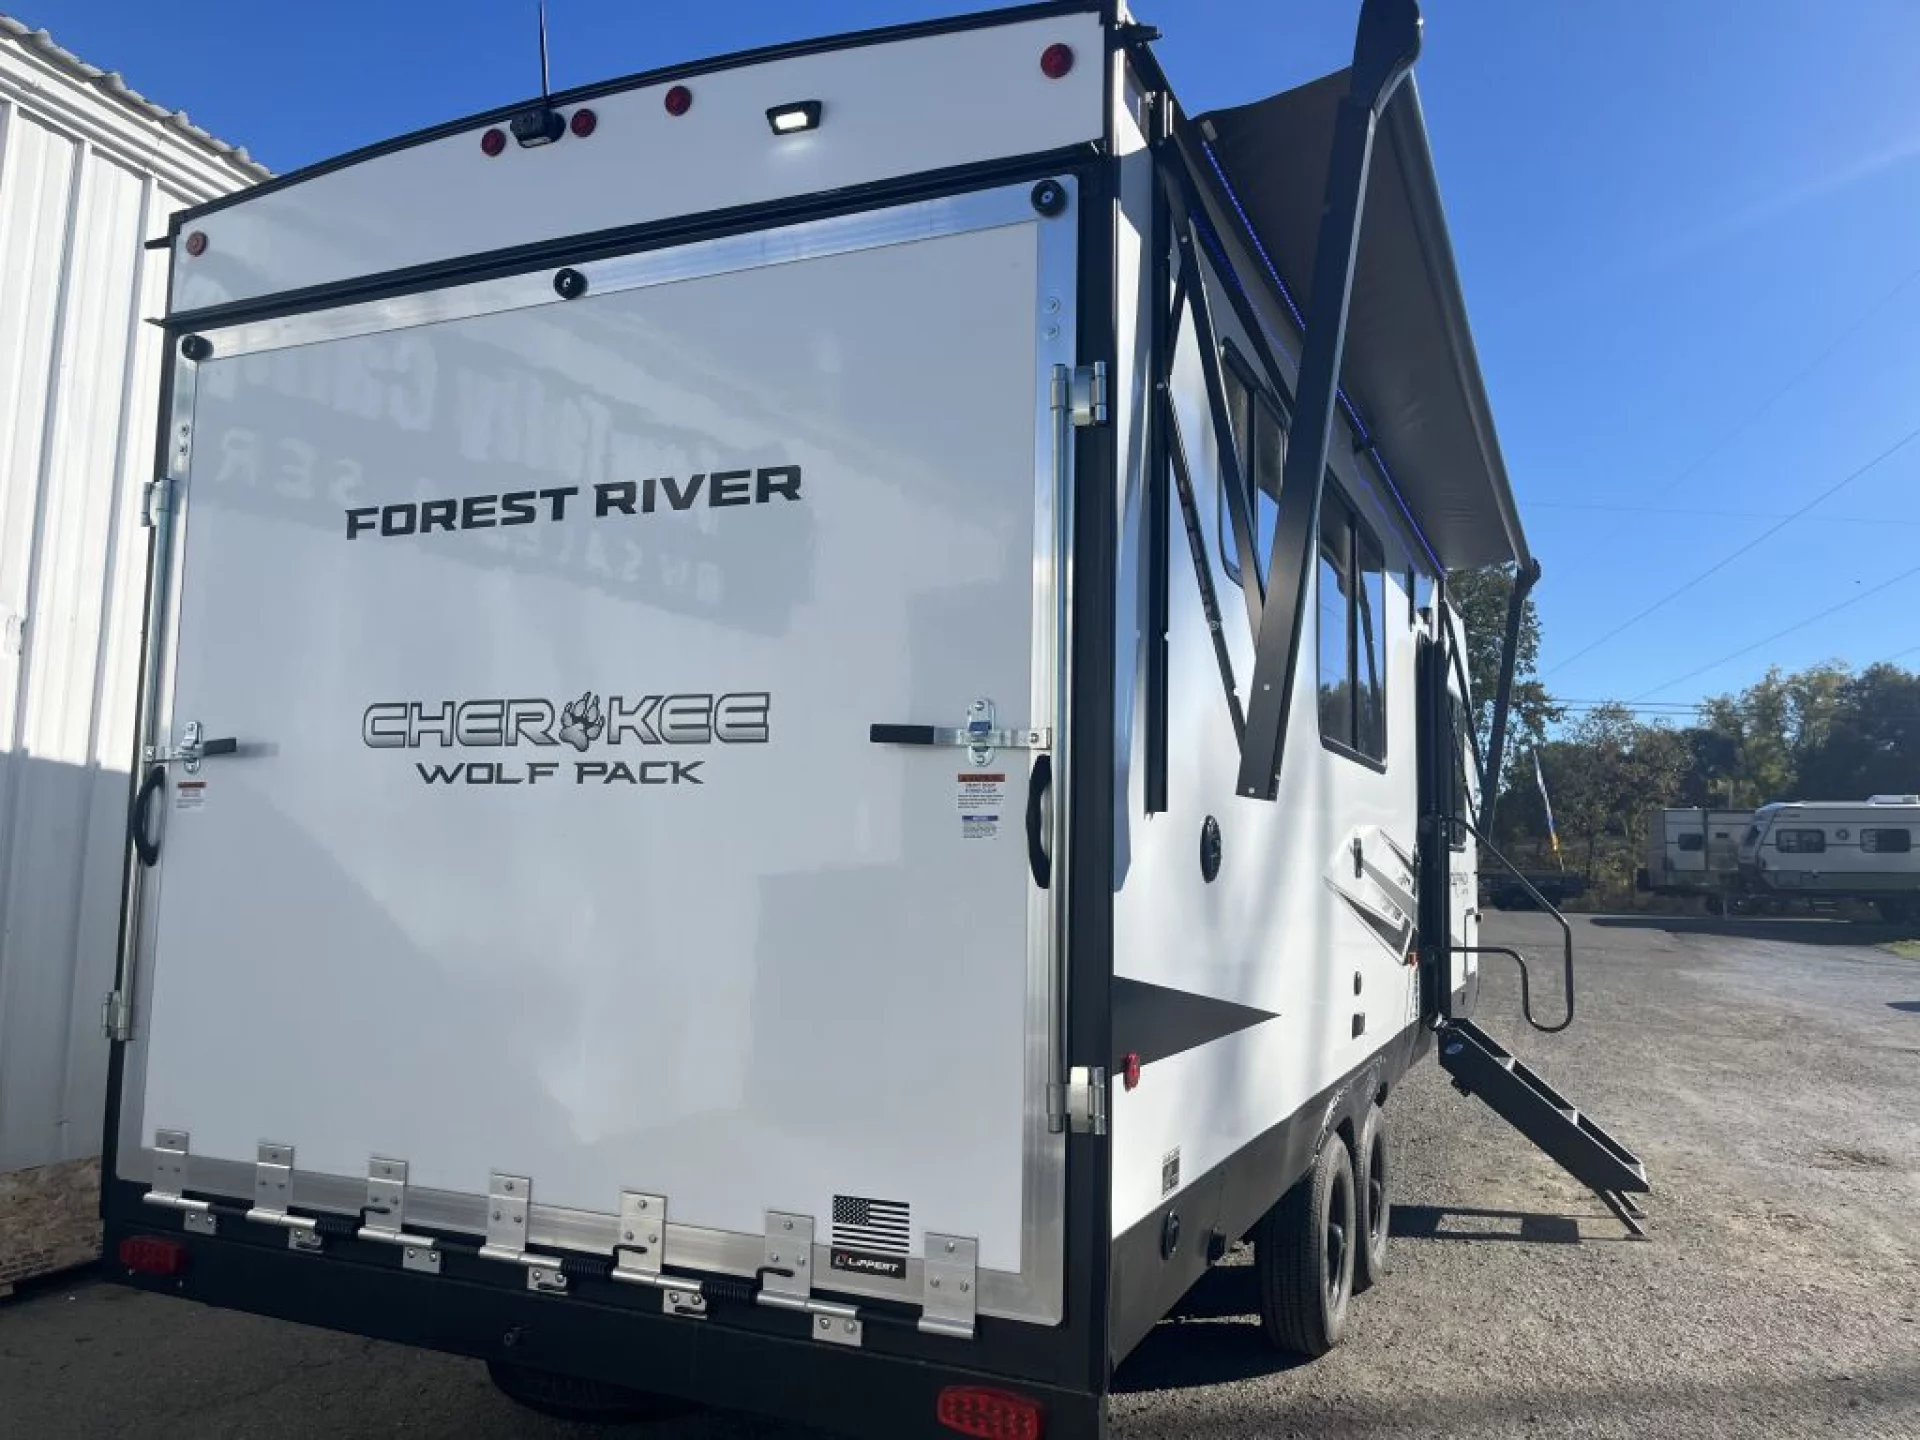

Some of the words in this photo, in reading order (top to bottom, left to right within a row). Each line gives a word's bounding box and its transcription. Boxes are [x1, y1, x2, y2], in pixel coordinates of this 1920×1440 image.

[345, 486, 580, 541] FOREST
[593, 464, 802, 518] RIVER
[415, 762, 560, 786] WOLF
[574, 760, 706, 785] PACK
